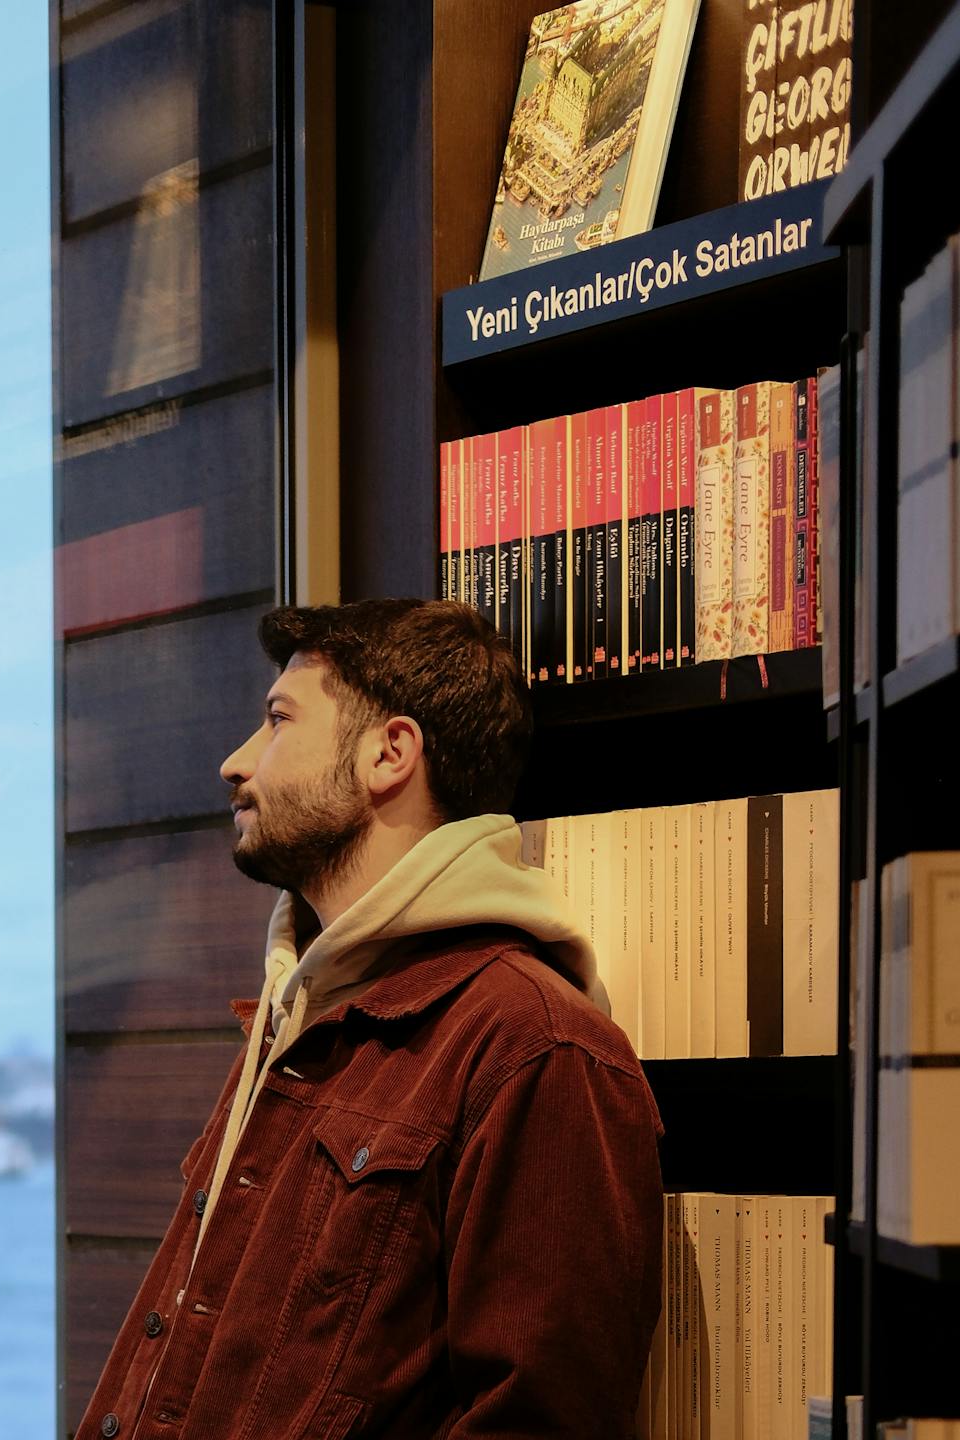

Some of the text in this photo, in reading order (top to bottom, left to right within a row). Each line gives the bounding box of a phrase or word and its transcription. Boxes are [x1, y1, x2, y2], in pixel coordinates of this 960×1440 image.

[519, 212, 585, 241] Haydarpaşa
[530, 233, 565, 255] Kitabı
[465, 216, 814, 343] Yeni Çıkanlar/Çok Satanlar
[665, 417, 674, 490] Virginia Woolf
[680, 414, 688, 488] Virginia Woolf
[776, 454, 784, 474] DON
[485, 458, 493, 525] Franz Kafka
[500, 456, 508, 522] Franz Kafka
[512, 451, 520, 506] Franz Kafka
[739, 473, 753, 514] Jane
[703, 482, 716, 522] Jane
[595, 532, 604, 558] Uzun
[608, 528, 618, 559] Eylül
[664, 517, 674, 568] Dalgalar
[680, 514, 689, 568] Orlando
[701, 530, 716, 568] Eyre
[738, 523, 752, 562] Eyre
[485, 552, 494, 606] Amerika
[500, 550, 509, 604] Amerika
[512, 546, 521, 580] Dava
[744, 1240, 752, 1282] THOMAS
[744, 1284, 752, 1314] MANN
[744, 1328, 752, 1342] Yol
